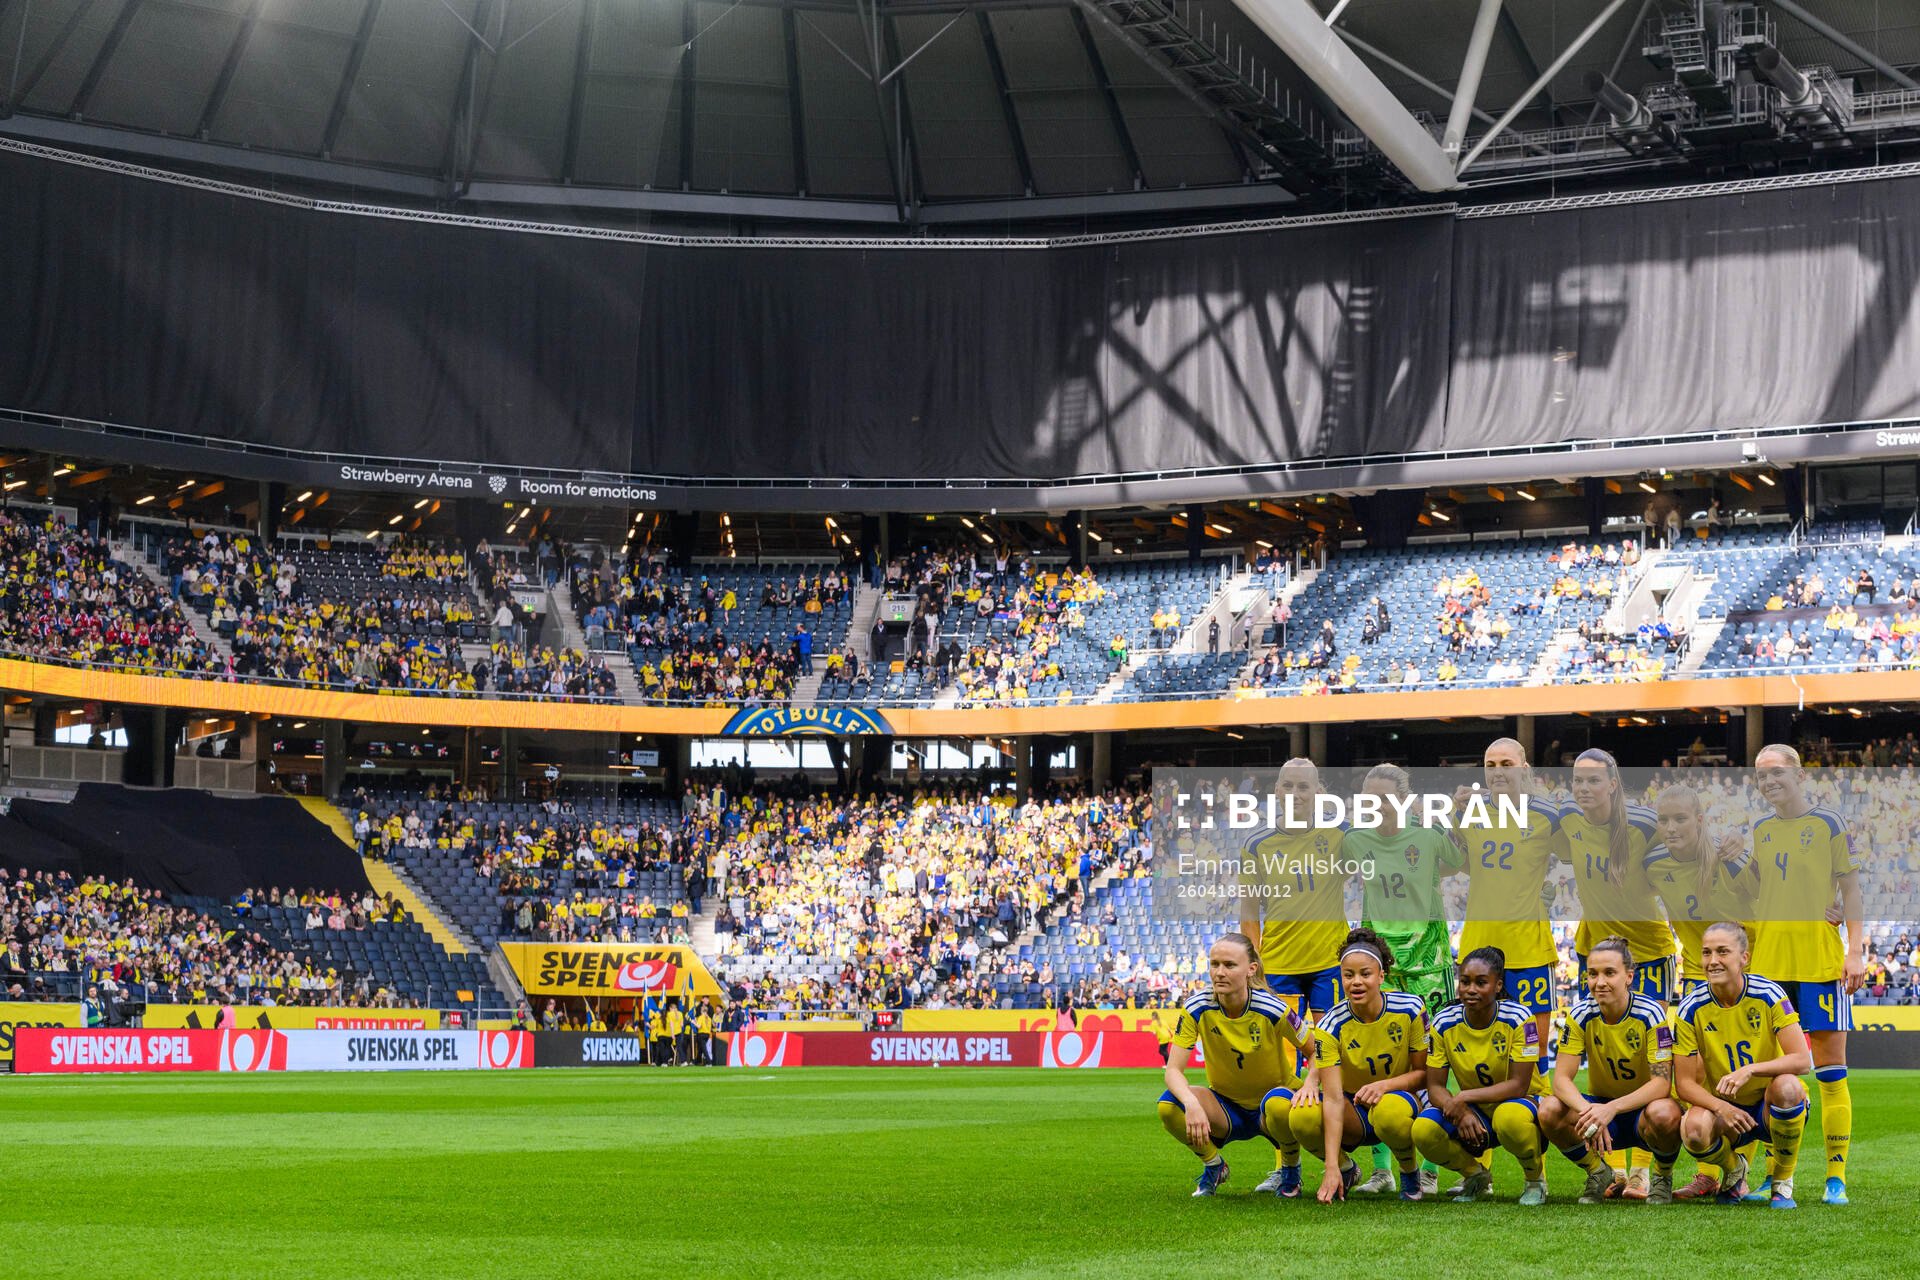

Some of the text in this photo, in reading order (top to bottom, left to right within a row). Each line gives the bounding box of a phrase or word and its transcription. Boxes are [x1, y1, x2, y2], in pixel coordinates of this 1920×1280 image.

[340, 466, 473, 489] Strawberry Arena
[520, 479, 657, 500] Room for emotions
[1482, 841, 1514, 870] 22
[1586, 853, 1609, 882] 14
[1775, 852, 1788, 880] 4
[1293, 866, 1314, 892] 11
[1379, 873, 1406, 899] 12
[1686, 895, 1702, 920] 2
[538, 971, 610, 988] SPEL
[1517, 977, 1549, 1007] 22
[1638, 966, 1662, 993] 14
[1819, 994, 1834, 1022] 4
[51, 1036, 143, 1065] SVENSKA
[147, 1036, 192, 1064] SPEL
[347, 1037, 458, 1062] SVENSKA SPEL
[582, 1037, 640, 1062] SVENSKA
[870, 1037, 1012, 1061] SVENSKA SPEL
[1231, 1048, 1244, 1070] 7
[1724, 1040, 1754, 1072] 16
[1366, 1053, 1393, 1076] 17
[1475, 1063, 1494, 1087] 6
[1606, 1057, 1636, 1080] 15
